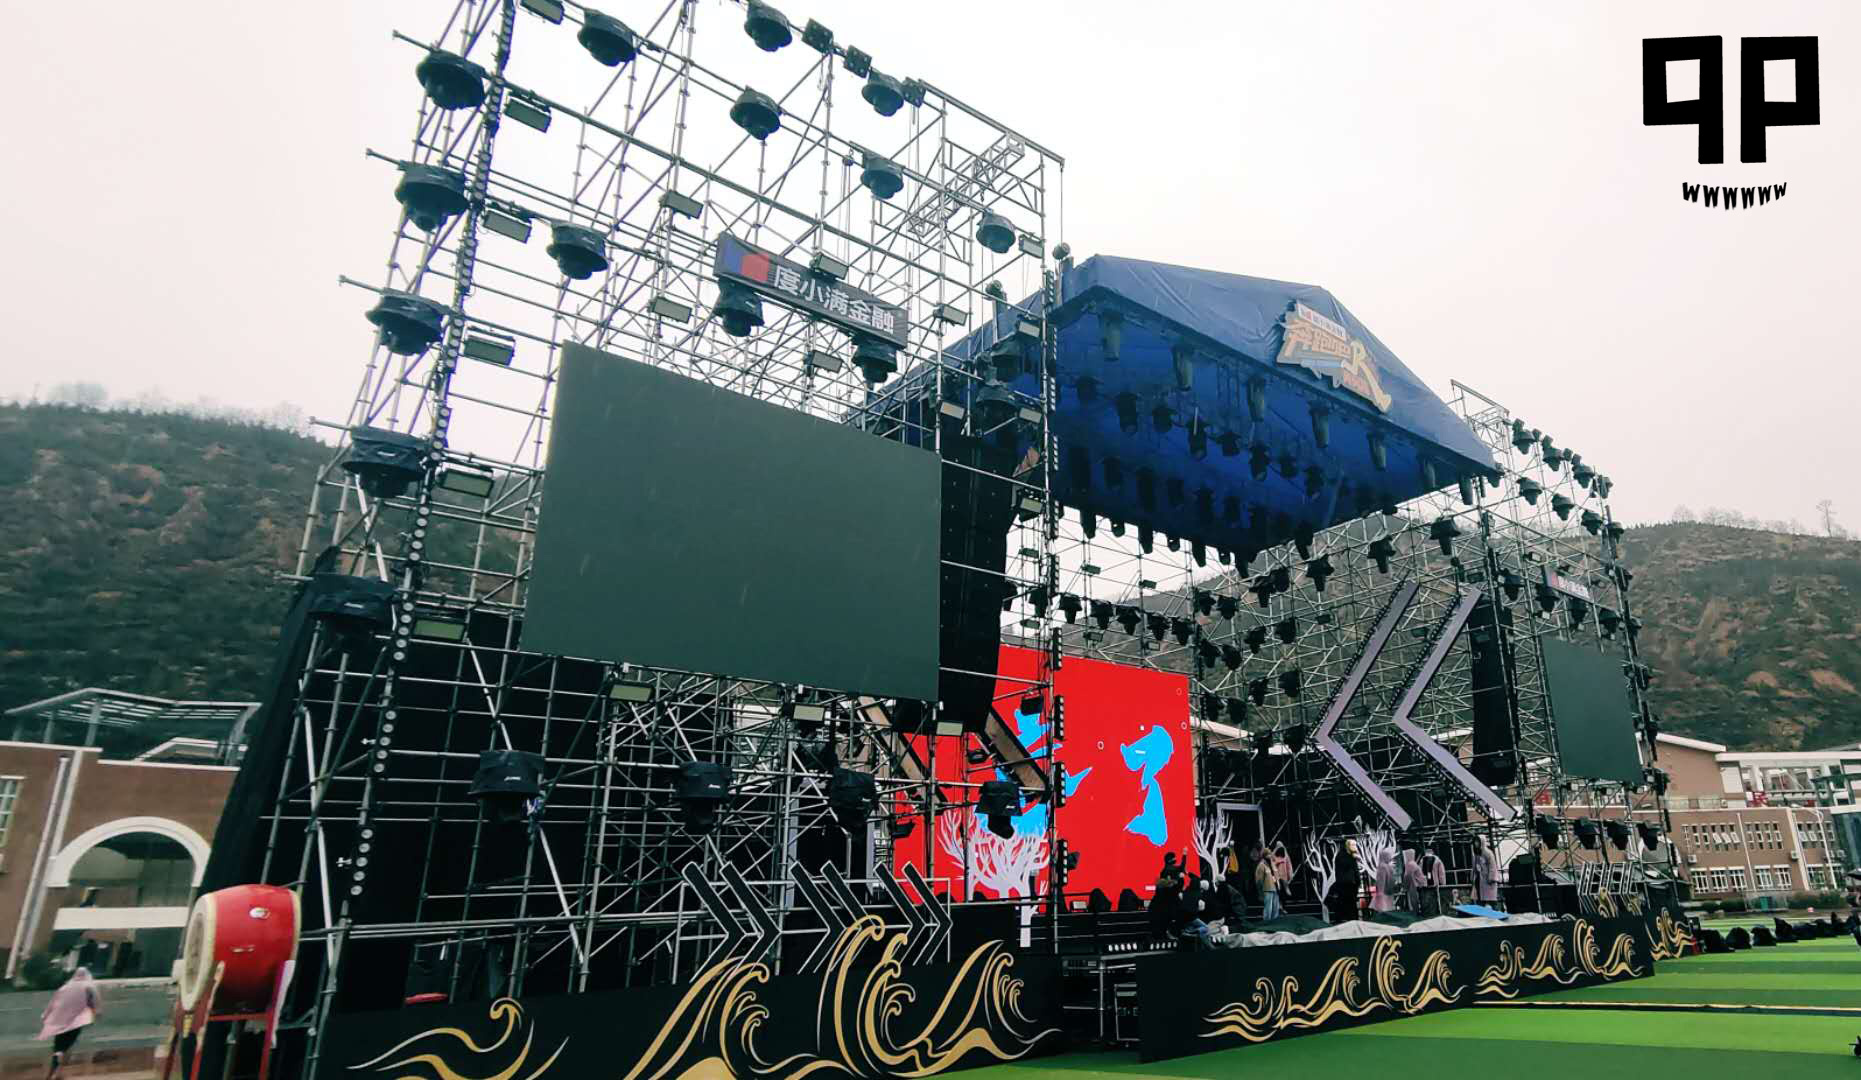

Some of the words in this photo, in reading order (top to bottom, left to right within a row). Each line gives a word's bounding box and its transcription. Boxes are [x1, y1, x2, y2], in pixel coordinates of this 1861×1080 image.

[774, 265, 894, 334] 度小满金融
